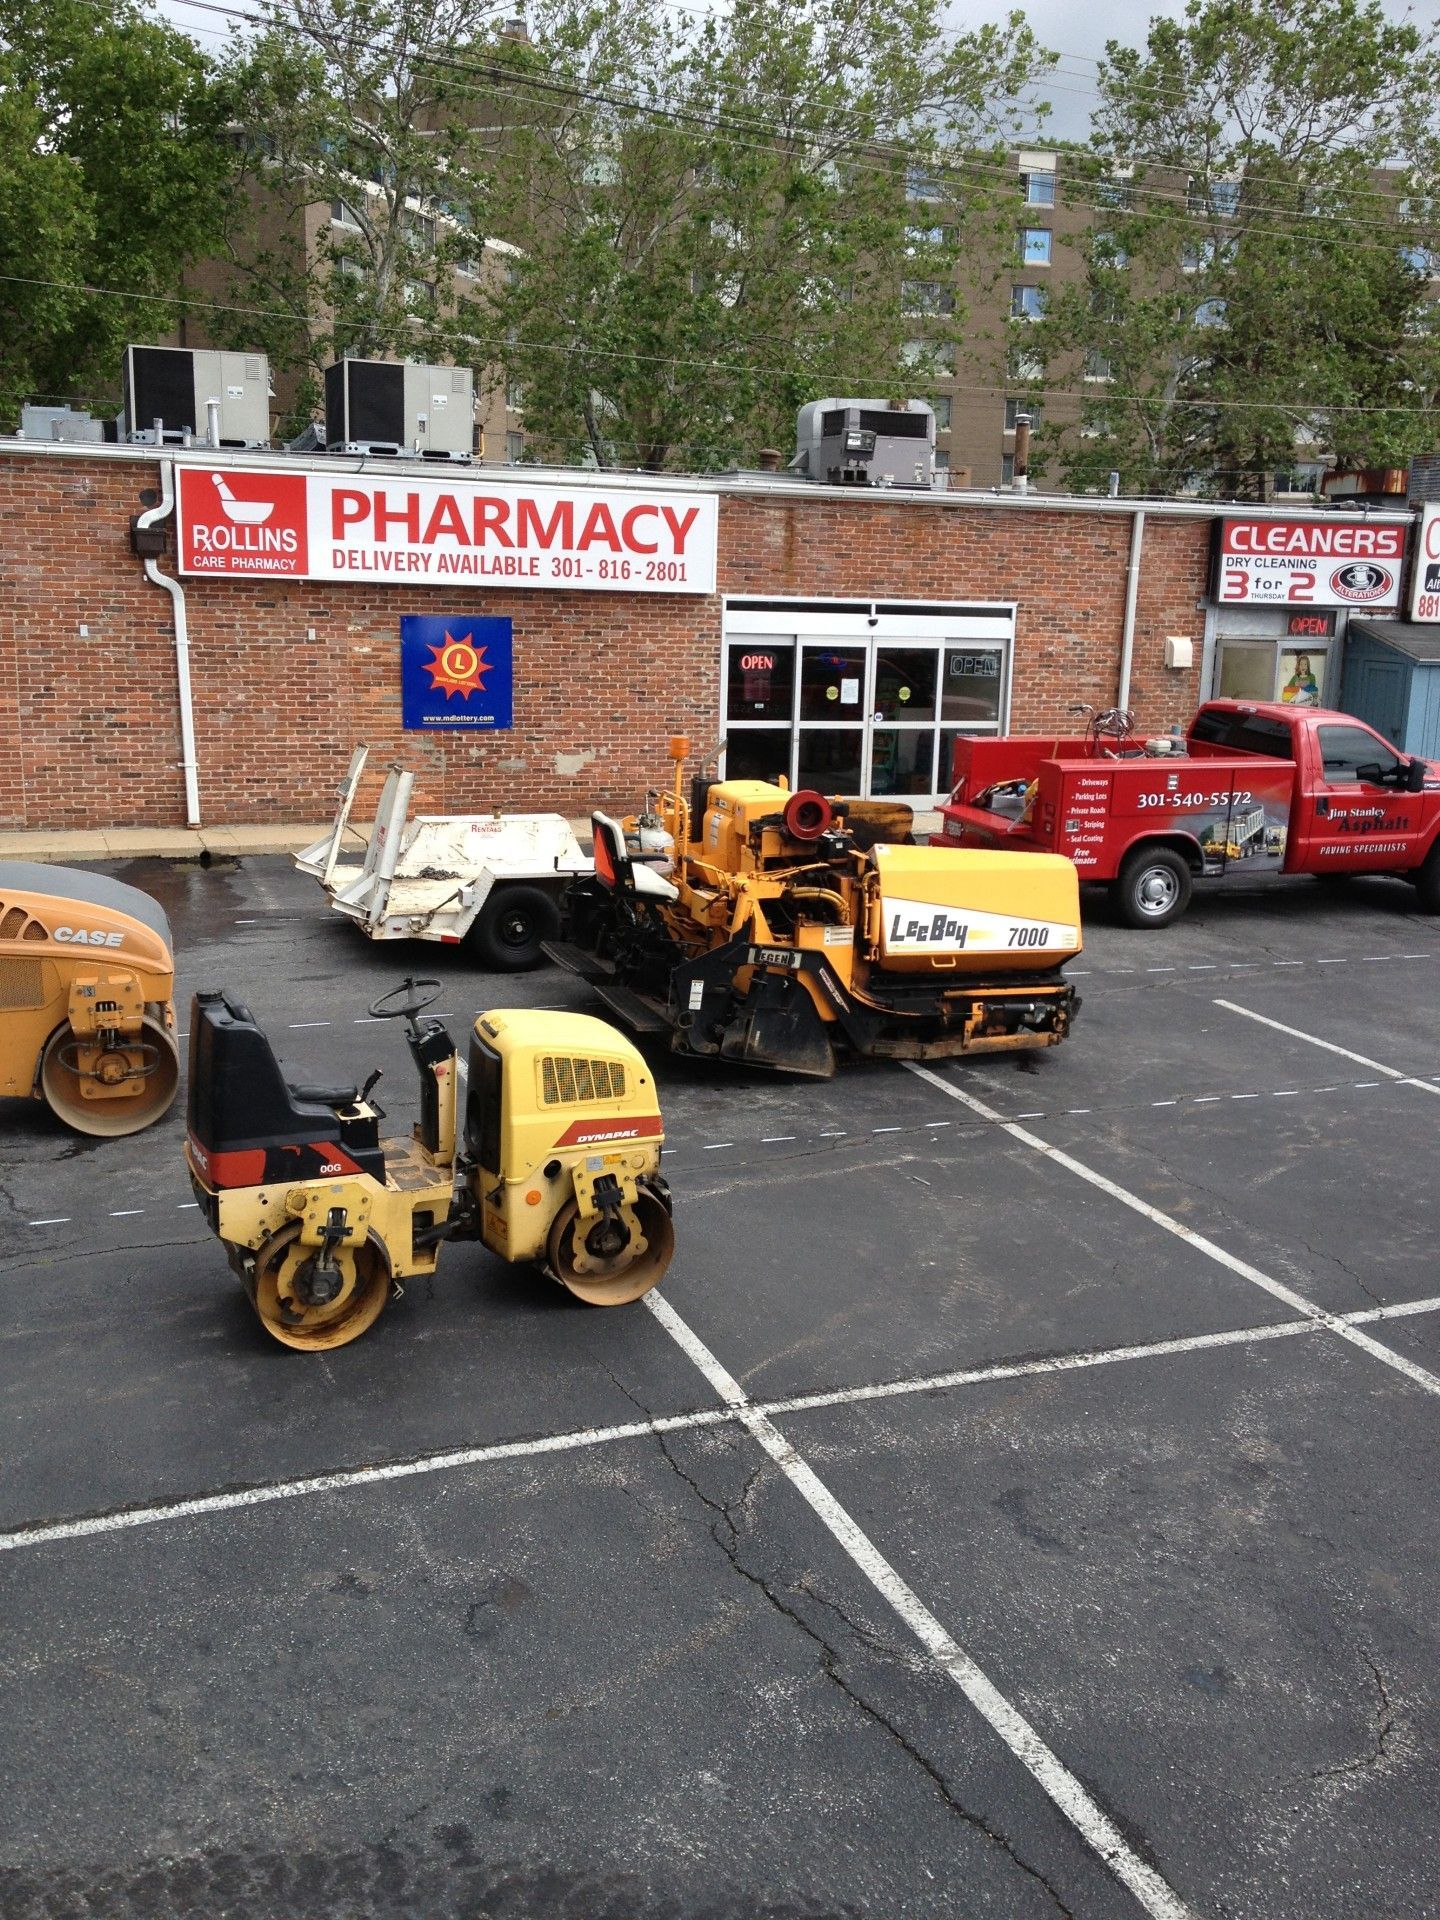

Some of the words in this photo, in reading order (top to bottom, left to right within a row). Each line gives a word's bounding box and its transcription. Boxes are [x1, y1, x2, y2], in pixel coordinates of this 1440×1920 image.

[331, 488, 700, 554] PHARMACY
[1229, 525, 1398, 554] CLEANERS
[193, 556, 226, 568] CARE
[231, 557, 297, 570] PHARMACY
[332, 549, 432, 573] DELIVERY
[437, 553, 540, 577] AVAILABLE
[1226, 557, 1251, 567] DRY
[1254, 558, 1317, 569] CLEANING
[1223, 570, 1250, 599] 3
[1254, 577, 1283, 590] for
[1288, 572, 1316, 601] 2
[1335, 585, 1386, 600] ALTERATIONS
[1251, 592, 1285, 600] THURSDAY
[1291, 617, 1328, 635] OPEN
[741, 655, 773, 670] OPEN
[953, 657, 994, 674] OPEN
[423, 715, 494, 723] www.mdlottery.com
[1081, 779, 1109, 787] Driveways
[1075, 793, 1095, 801] Parking
[1137, 791, 1252, 808] 301-540-5572
[1327, 808, 1347, 820] Jim
[1350, 807, 1387, 818] Stanley
[1084, 821, 1105, 829] Striping
[1337, 815, 1410, 834] Asphalt
[1071, 835, 1081, 843] Seal
[1083, 835, 1104, 843] Coating
[1074, 848, 1090, 857] Free
[1320, 845, 1351, 855] PAVING
[1354, 843, 1407, 854] SPECIALISTS
[54, 926, 125, 947] CASE
[1008, 928, 1050, 947] 7000
[576, 1129, 639, 1143] DYNAPAC
